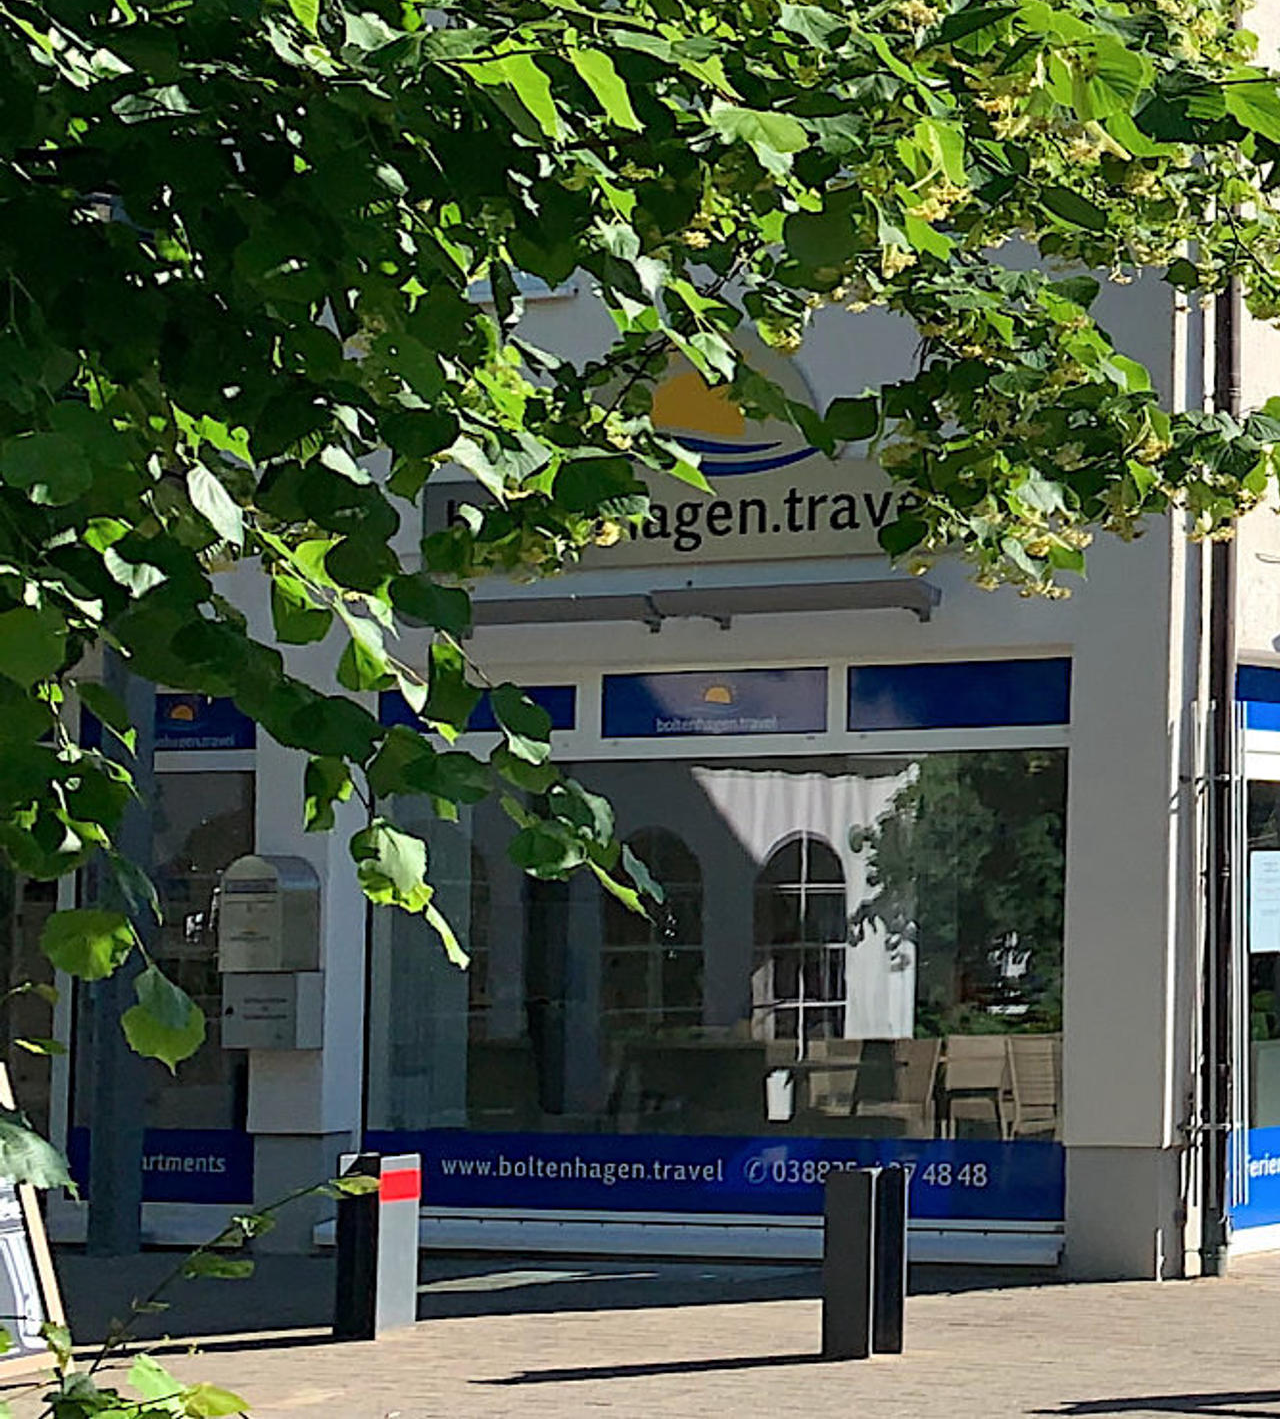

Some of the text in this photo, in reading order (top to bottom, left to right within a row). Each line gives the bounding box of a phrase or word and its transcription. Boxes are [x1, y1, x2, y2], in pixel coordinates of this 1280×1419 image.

[440, 1155, 724, 1186] www.boltenhagen.travel
[922, 1162, 952, 1187] 48
[957, 1163, 989, 1188] 48
